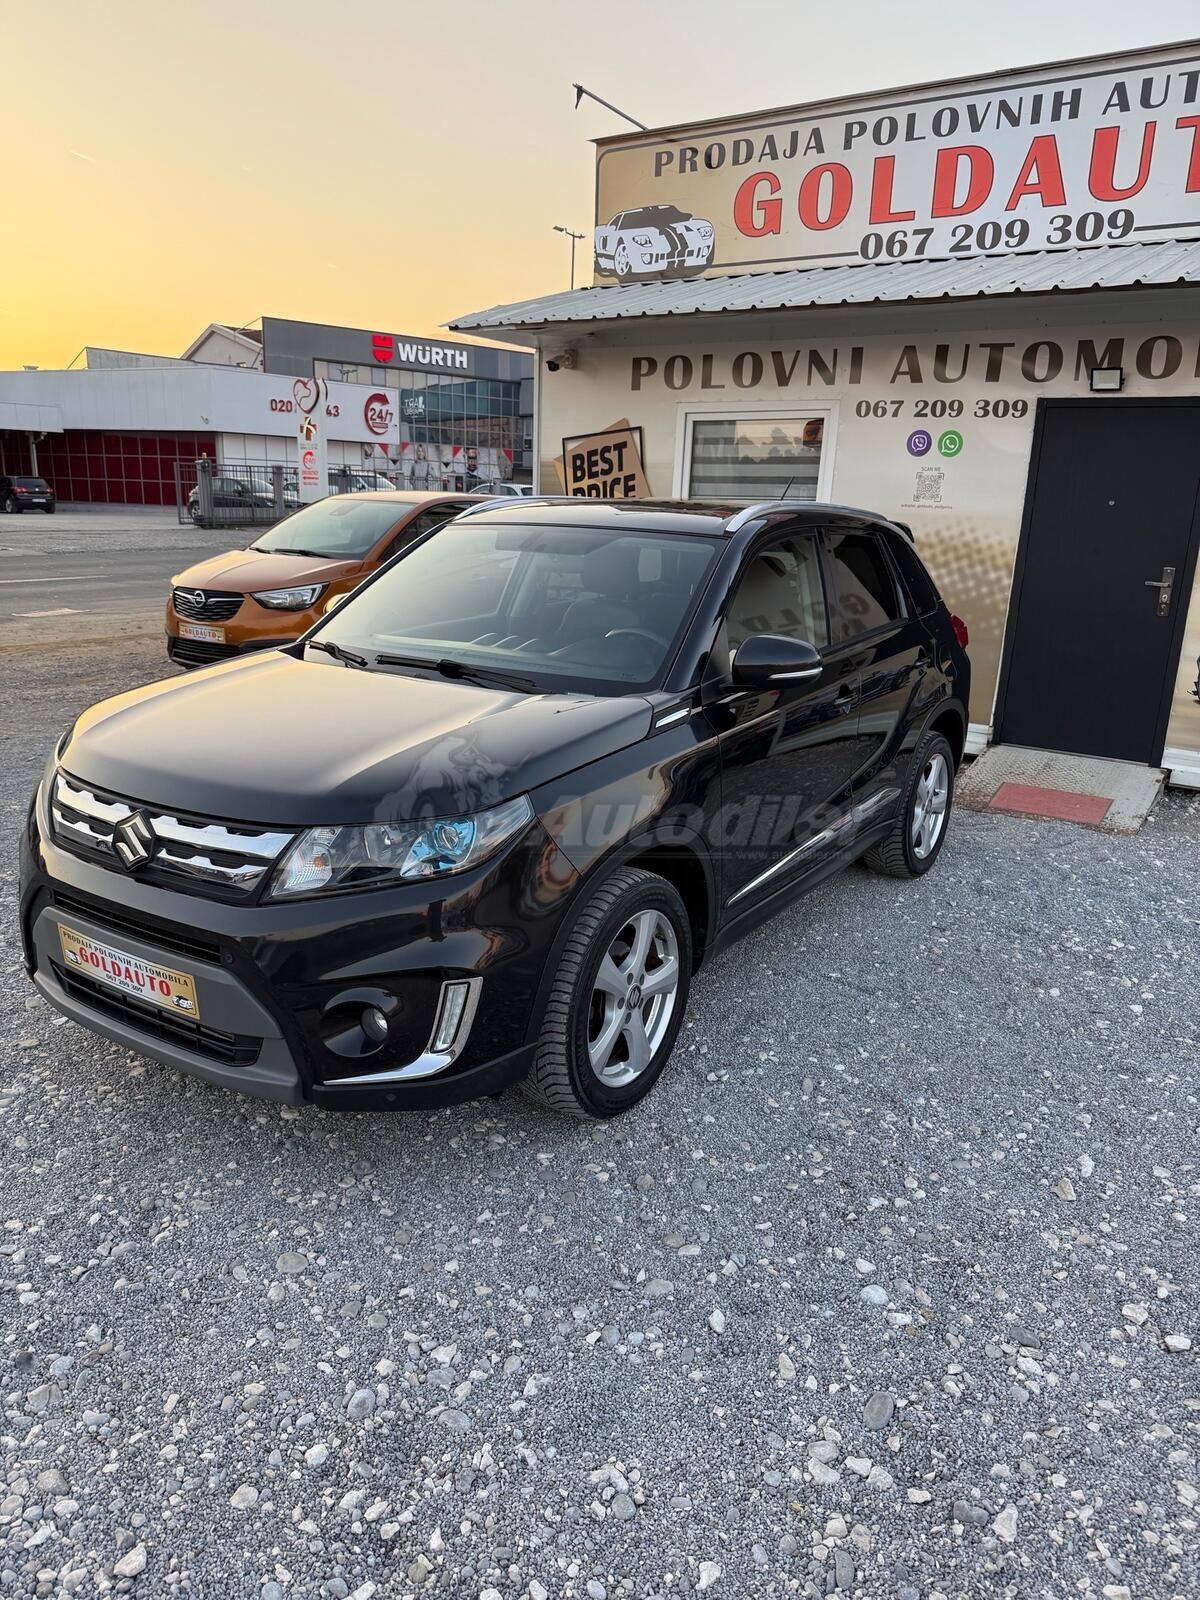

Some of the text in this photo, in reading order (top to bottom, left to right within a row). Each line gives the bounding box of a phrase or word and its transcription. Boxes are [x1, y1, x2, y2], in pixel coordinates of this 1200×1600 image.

[654, 127, 826, 177] PRODAJA
[843, 88, 1082, 150] POLOVNIH
[859, 208, 1135, 260] 067 209 309
[397, 342, 468, 369] WÜRTH
[629, 335, 1200, 392] POLOVNI AUTOMO
[370, 407, 394, 423] 24/7
[855, 398, 1028, 420] 067 209 309
[572, 440, 628, 483] BEST
[63, 931, 188, 987] PRODAJA POLOVNIH AUTOMOBILA
[80, 946, 172, 997] GOLDAUTO
